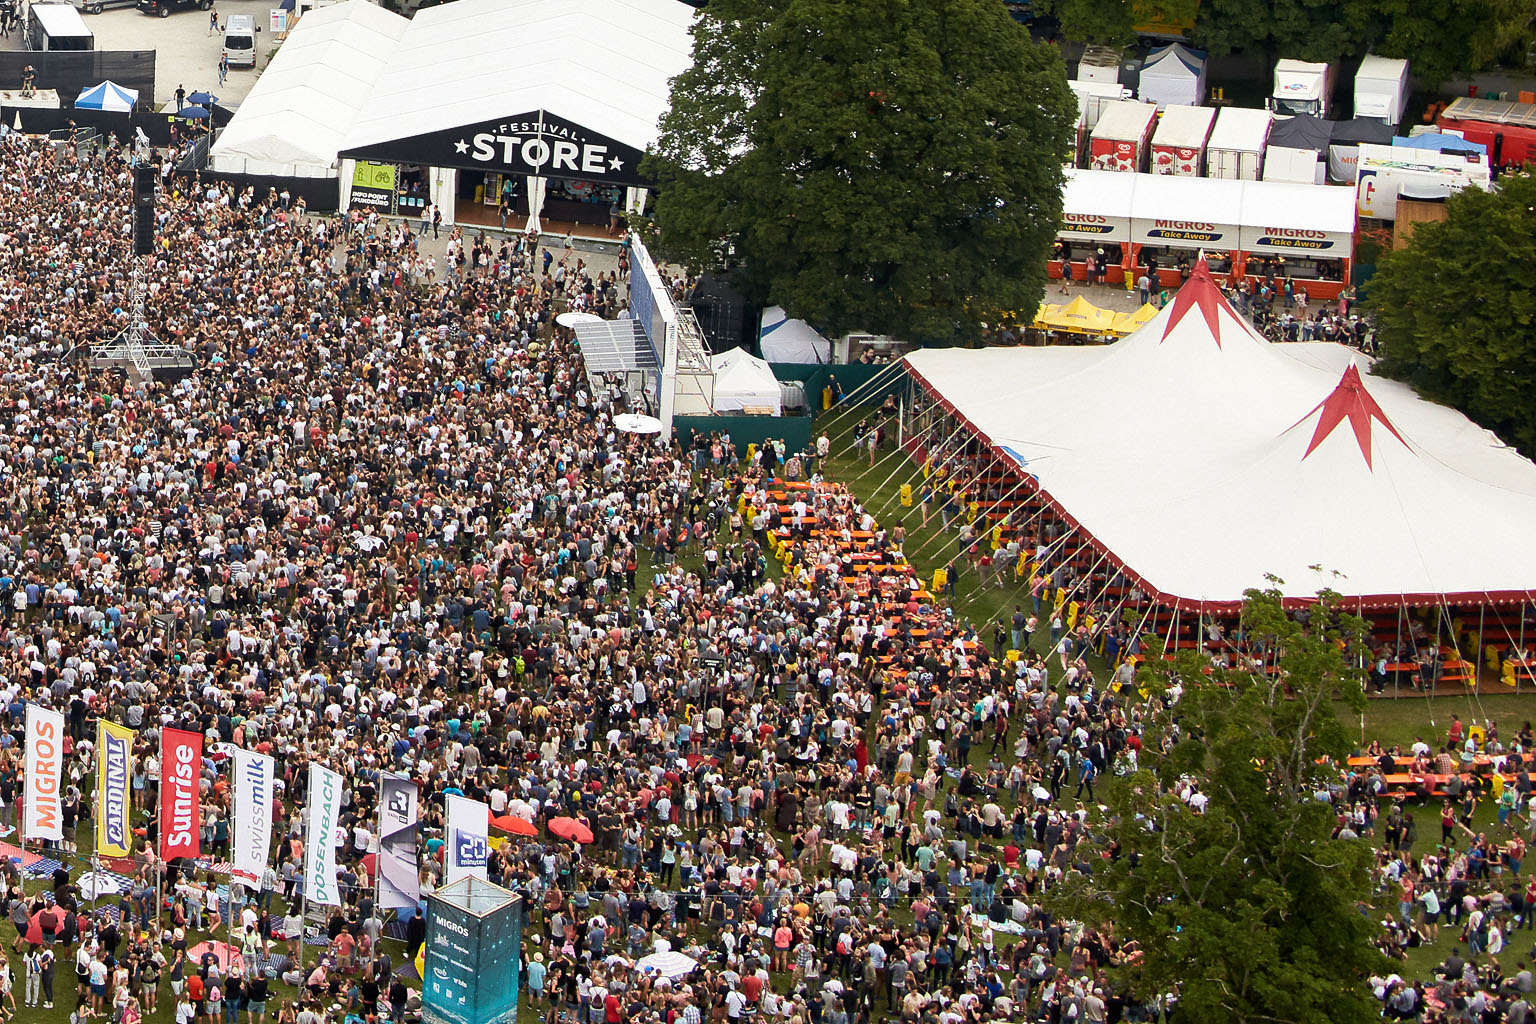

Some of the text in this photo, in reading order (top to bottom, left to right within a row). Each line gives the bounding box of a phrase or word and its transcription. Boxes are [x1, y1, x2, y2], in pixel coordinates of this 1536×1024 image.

[499, 122, 579, 142] FESTIVAL
[471, 132, 608, 174] STORE
[1062, 212, 1107, 224] IGROS
[1154, 219, 1216, 232] MIGROS
[1160, 230, 1211, 242] Take Away
[1264, 226, 1327, 239] MIGROS
[1269, 237, 1322, 249] Take Away
[35, 719, 57, 830] MIGROS
[108, 739, 126, 842] CARDINAL
[167, 744, 194, 847] Sunrise
[246, 758, 265, 863] swissmilk
[314, 771, 334, 901] DOSENBACH
[460, 833, 486, 859] 20
[460, 858, 486, 866] minuten
[436, 915, 469, 937] MIGROS
